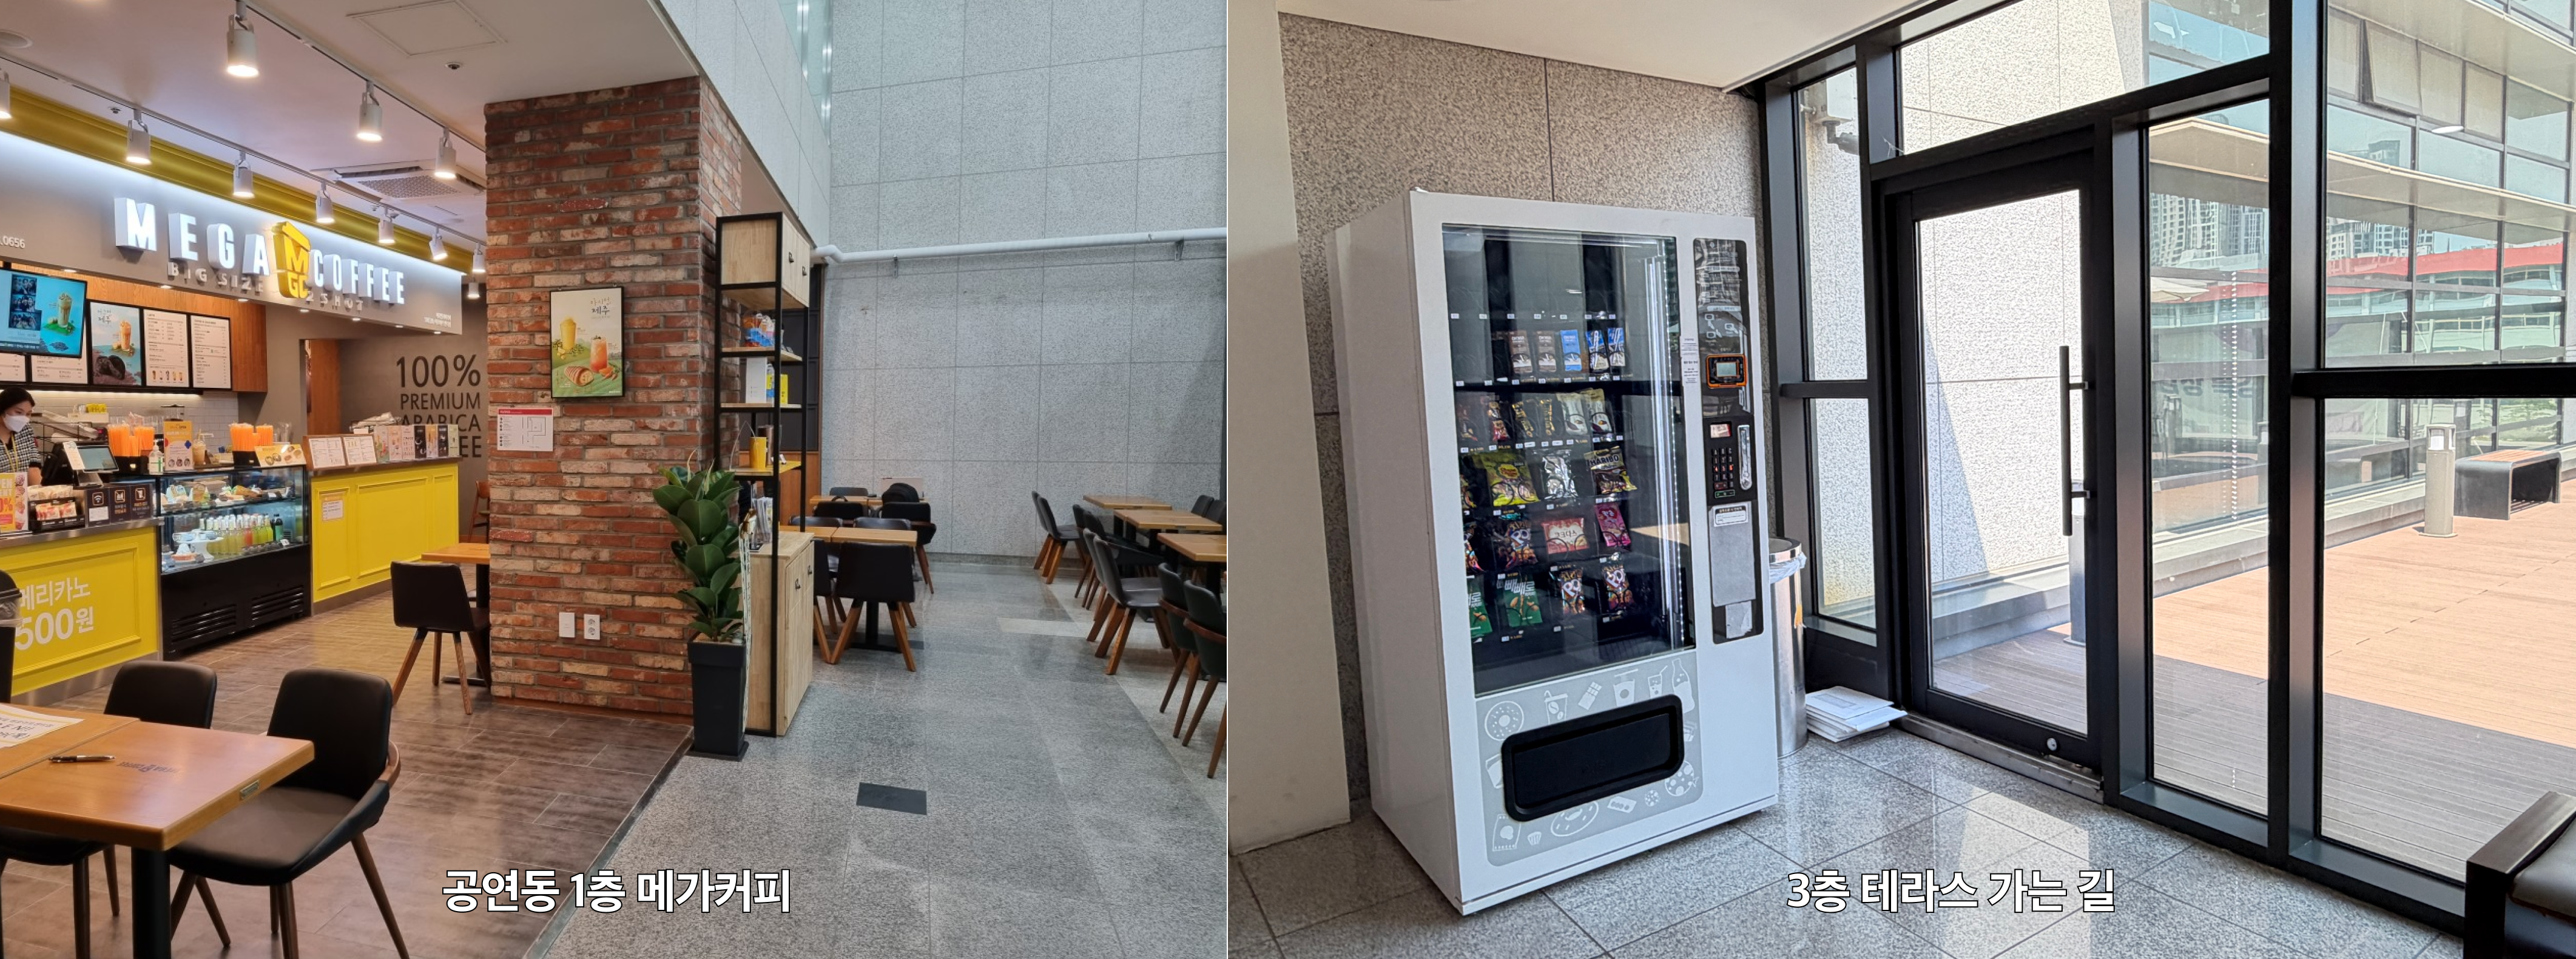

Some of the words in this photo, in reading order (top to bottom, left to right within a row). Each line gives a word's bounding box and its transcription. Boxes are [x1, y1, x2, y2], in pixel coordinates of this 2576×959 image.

[0, 235, 25, 249] .0656
[115, 197, 269, 276] MEGA
[306, 249, 405, 305] COFFEE
[167, 262, 207, 282] BIG
[217, 273, 264, 293] SIZE
[320, 293, 363, 311] SHOT
[396, 354, 481, 387] 100%
[400, 393, 481, 410] PREMIUM
[1590, 455, 1619, 466] HARIBO
[20, 577, 91, 610] 메리카노
[1505, 578, 1536, 595] 빼빼로
